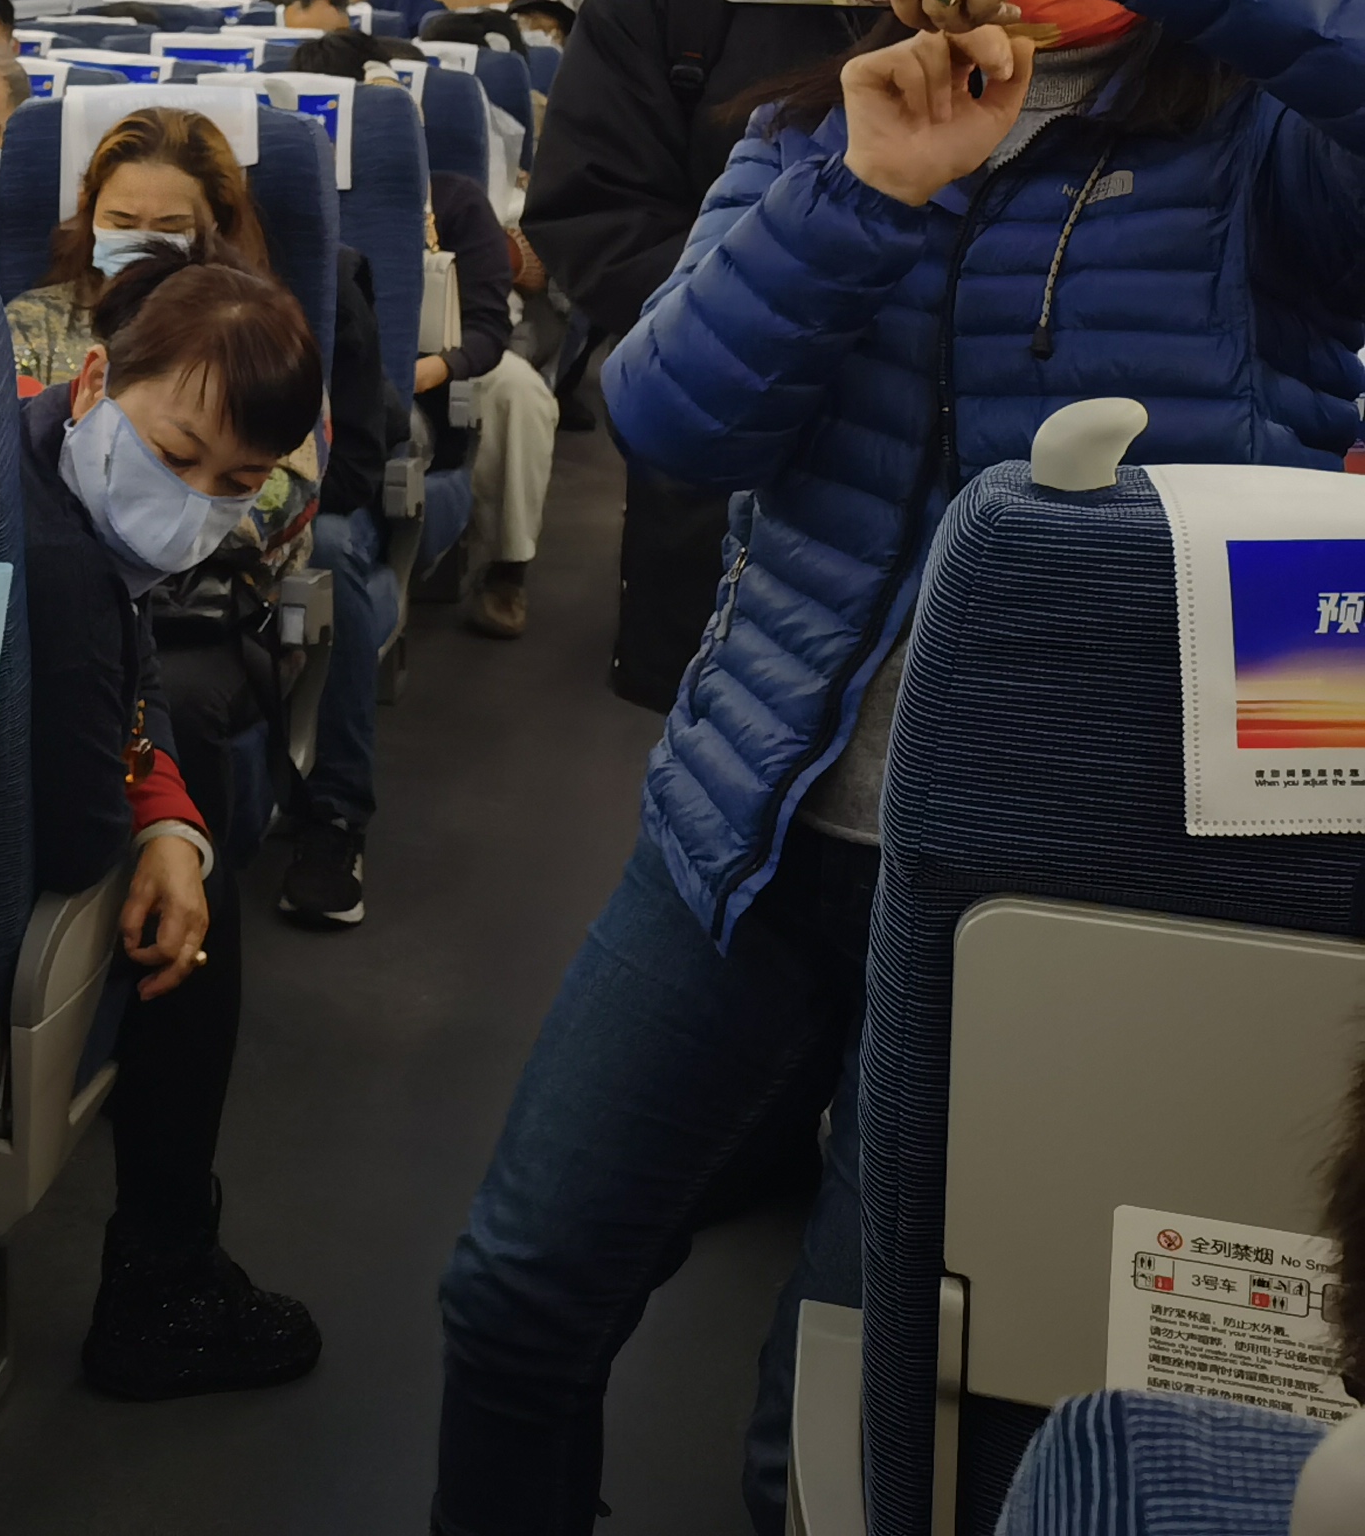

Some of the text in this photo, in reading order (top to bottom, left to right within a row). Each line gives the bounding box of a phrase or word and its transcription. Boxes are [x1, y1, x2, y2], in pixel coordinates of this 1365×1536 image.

[1190, 1236, 1274, 1265] 全列禁烟
[1281, 1254, 1301, 1268] No
[1191, 1274, 1238, 1294] 3号车
